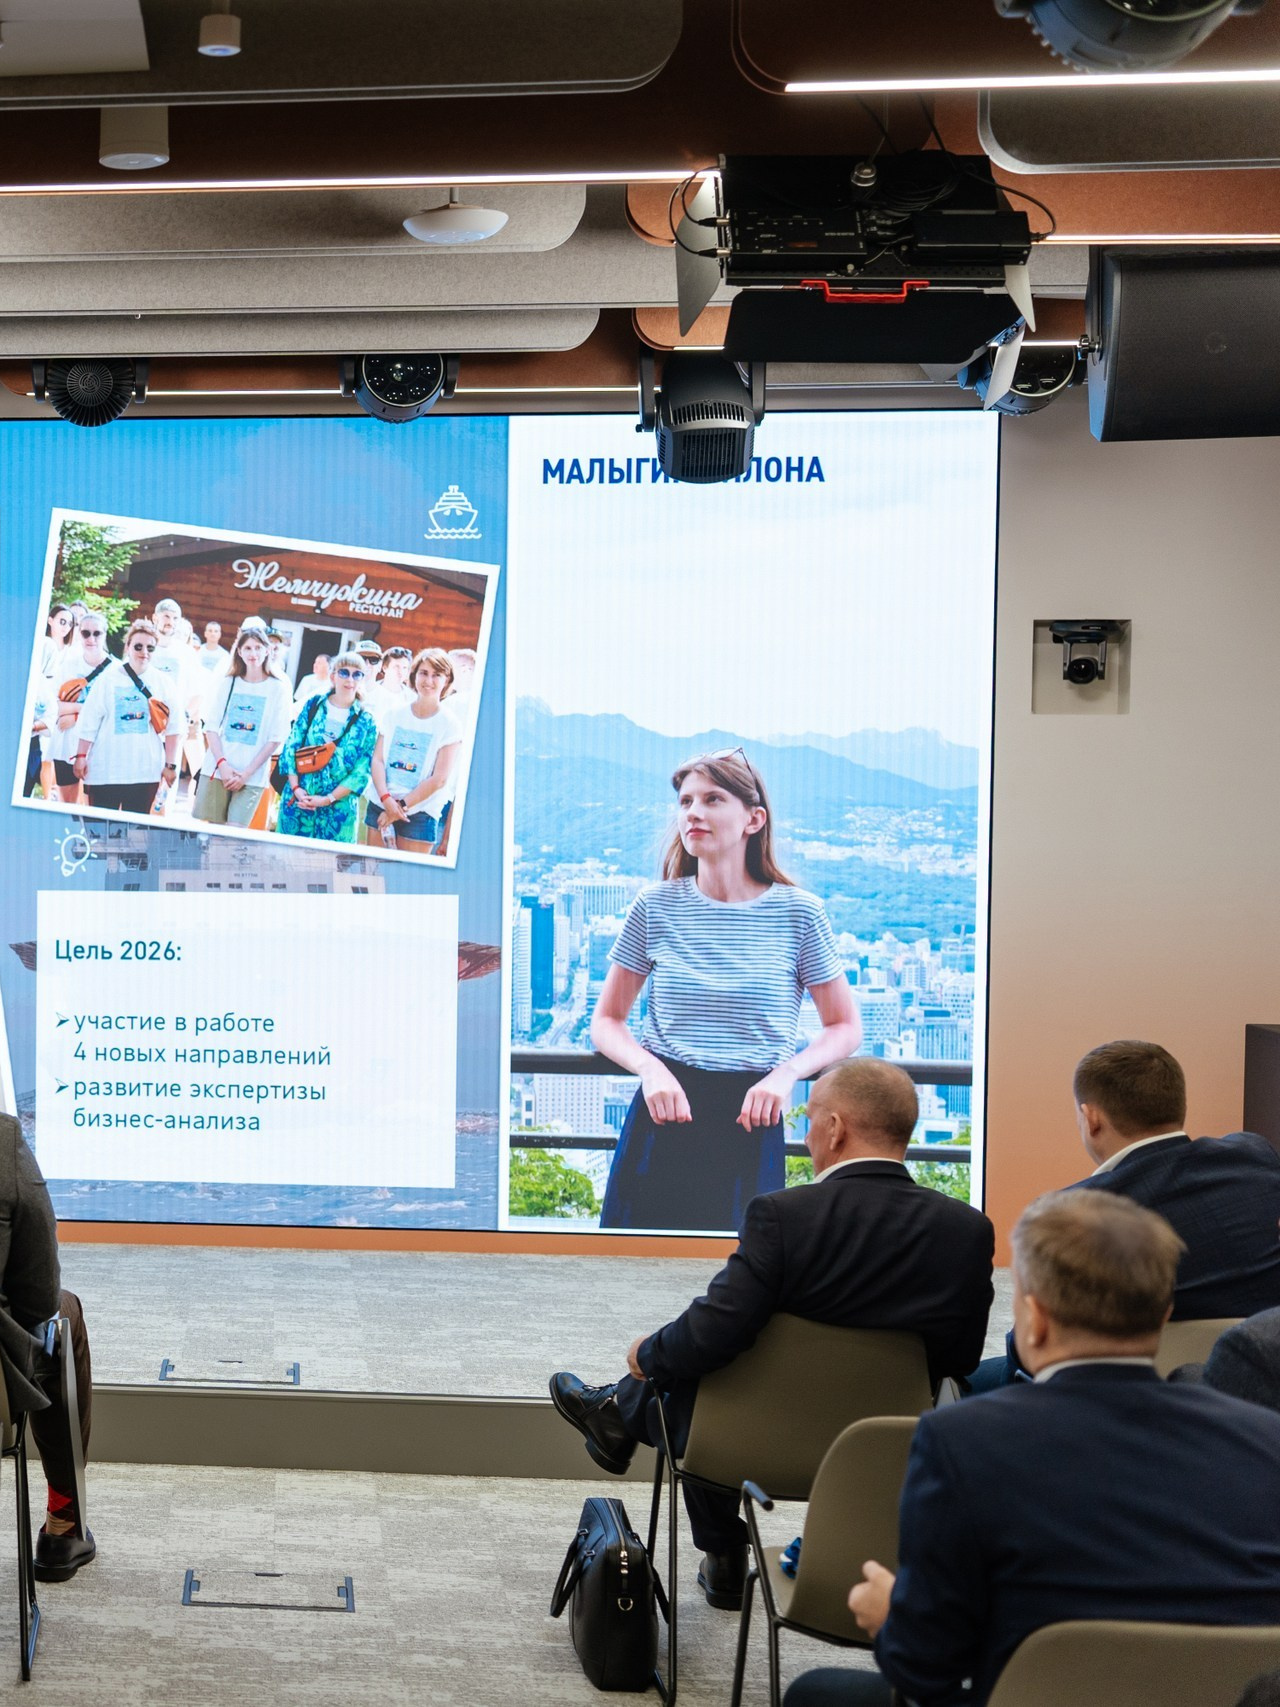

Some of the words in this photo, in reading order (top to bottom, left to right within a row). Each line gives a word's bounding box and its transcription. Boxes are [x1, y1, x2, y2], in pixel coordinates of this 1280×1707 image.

[542, 457, 679, 485] МАЛЫГИ
[722, 456, 826, 483] ЛОНА
[231, 557, 424, 610] Жемчужина
[348, 601, 404, 619] РЕСТОРАН
[55, 940, 113, 963] Цель
[120, 940, 182, 962] 2026:
[73, 1014, 166, 1035] участие
[175, 1016, 187, 1032] в
[195, 1011, 275, 1037] работе
[73, 1041, 87, 1061] 4
[95, 1046, 167, 1063] новых
[175, 1045, 332, 1069] направлений
[74, 1080, 182, 1100] развитие
[189, 1083, 326, 1105] экспертизы
[73, 1107, 261, 1131] бизнес-анализа
